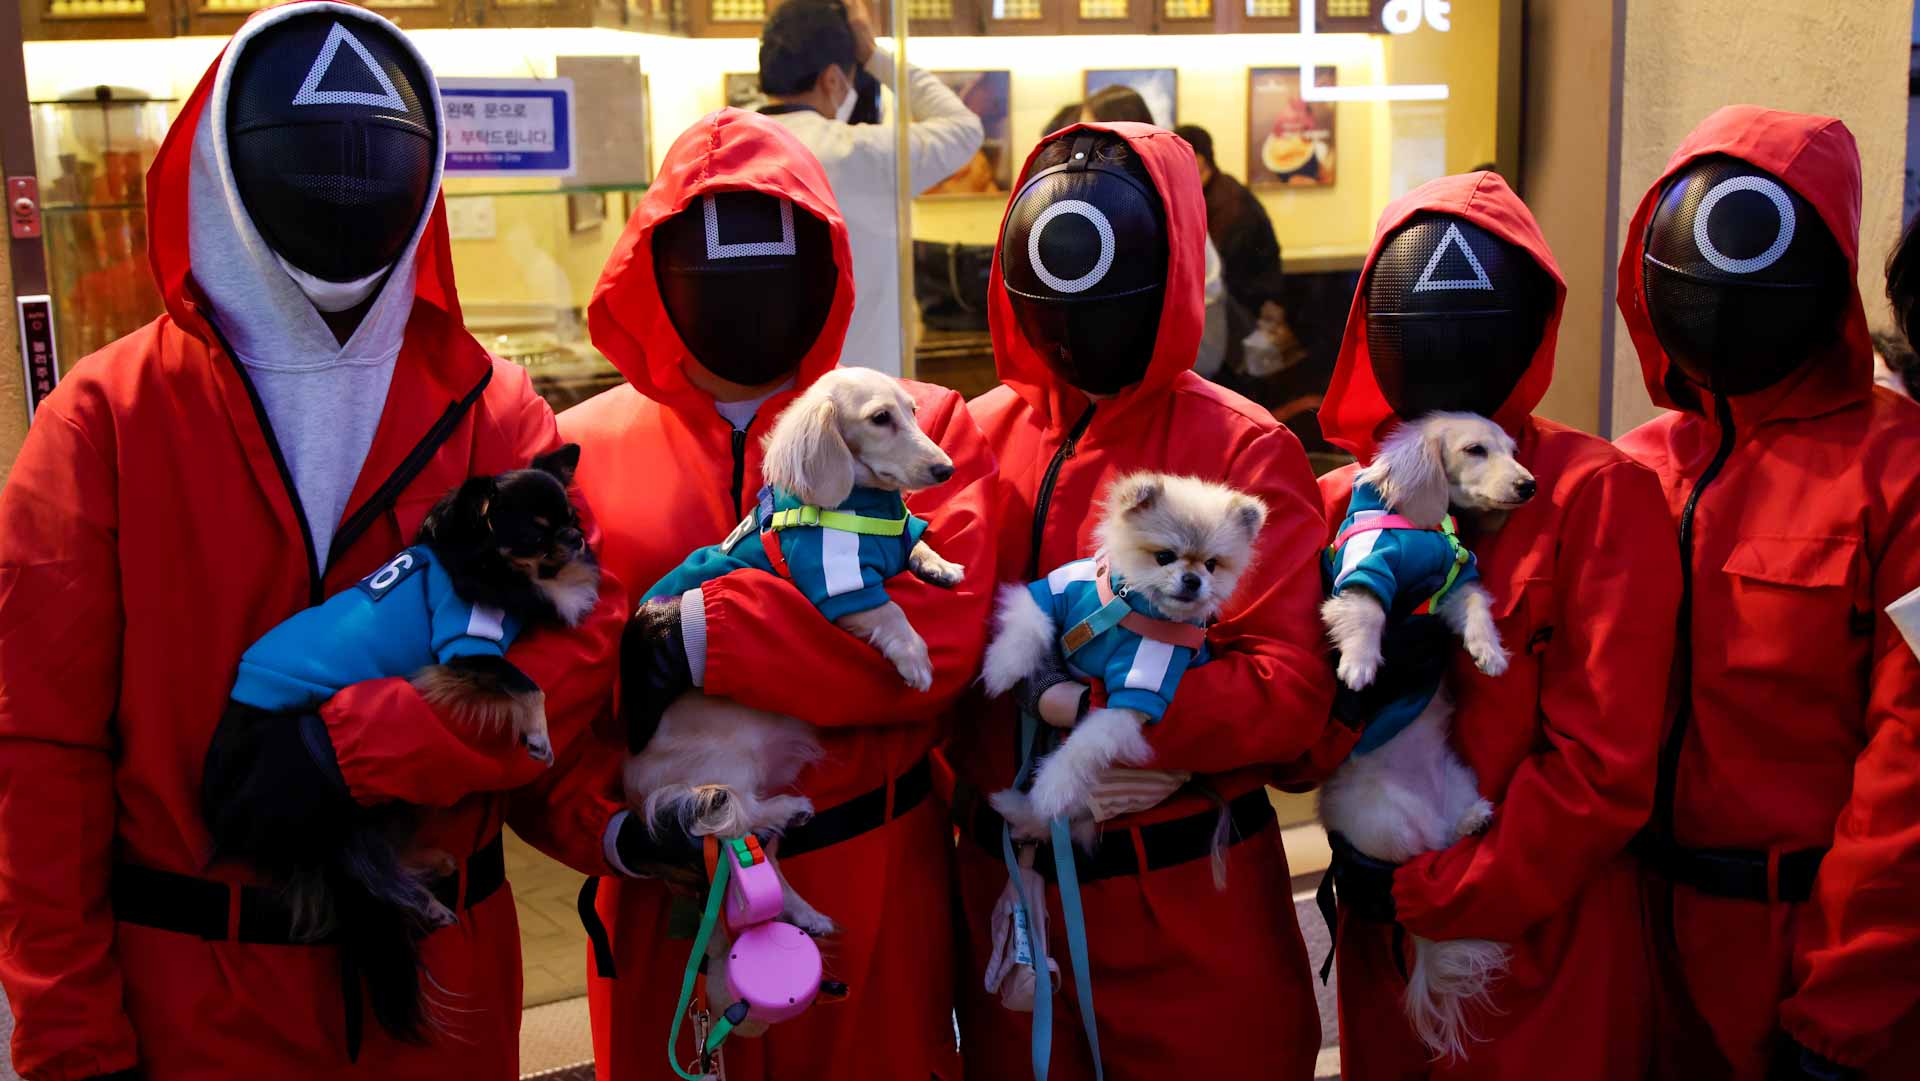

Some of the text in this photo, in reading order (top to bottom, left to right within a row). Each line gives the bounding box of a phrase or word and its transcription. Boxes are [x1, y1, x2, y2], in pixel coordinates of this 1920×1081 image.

[447, 102, 527, 119] 왼쪽 문으로
[362, 552, 413, 589] 6
